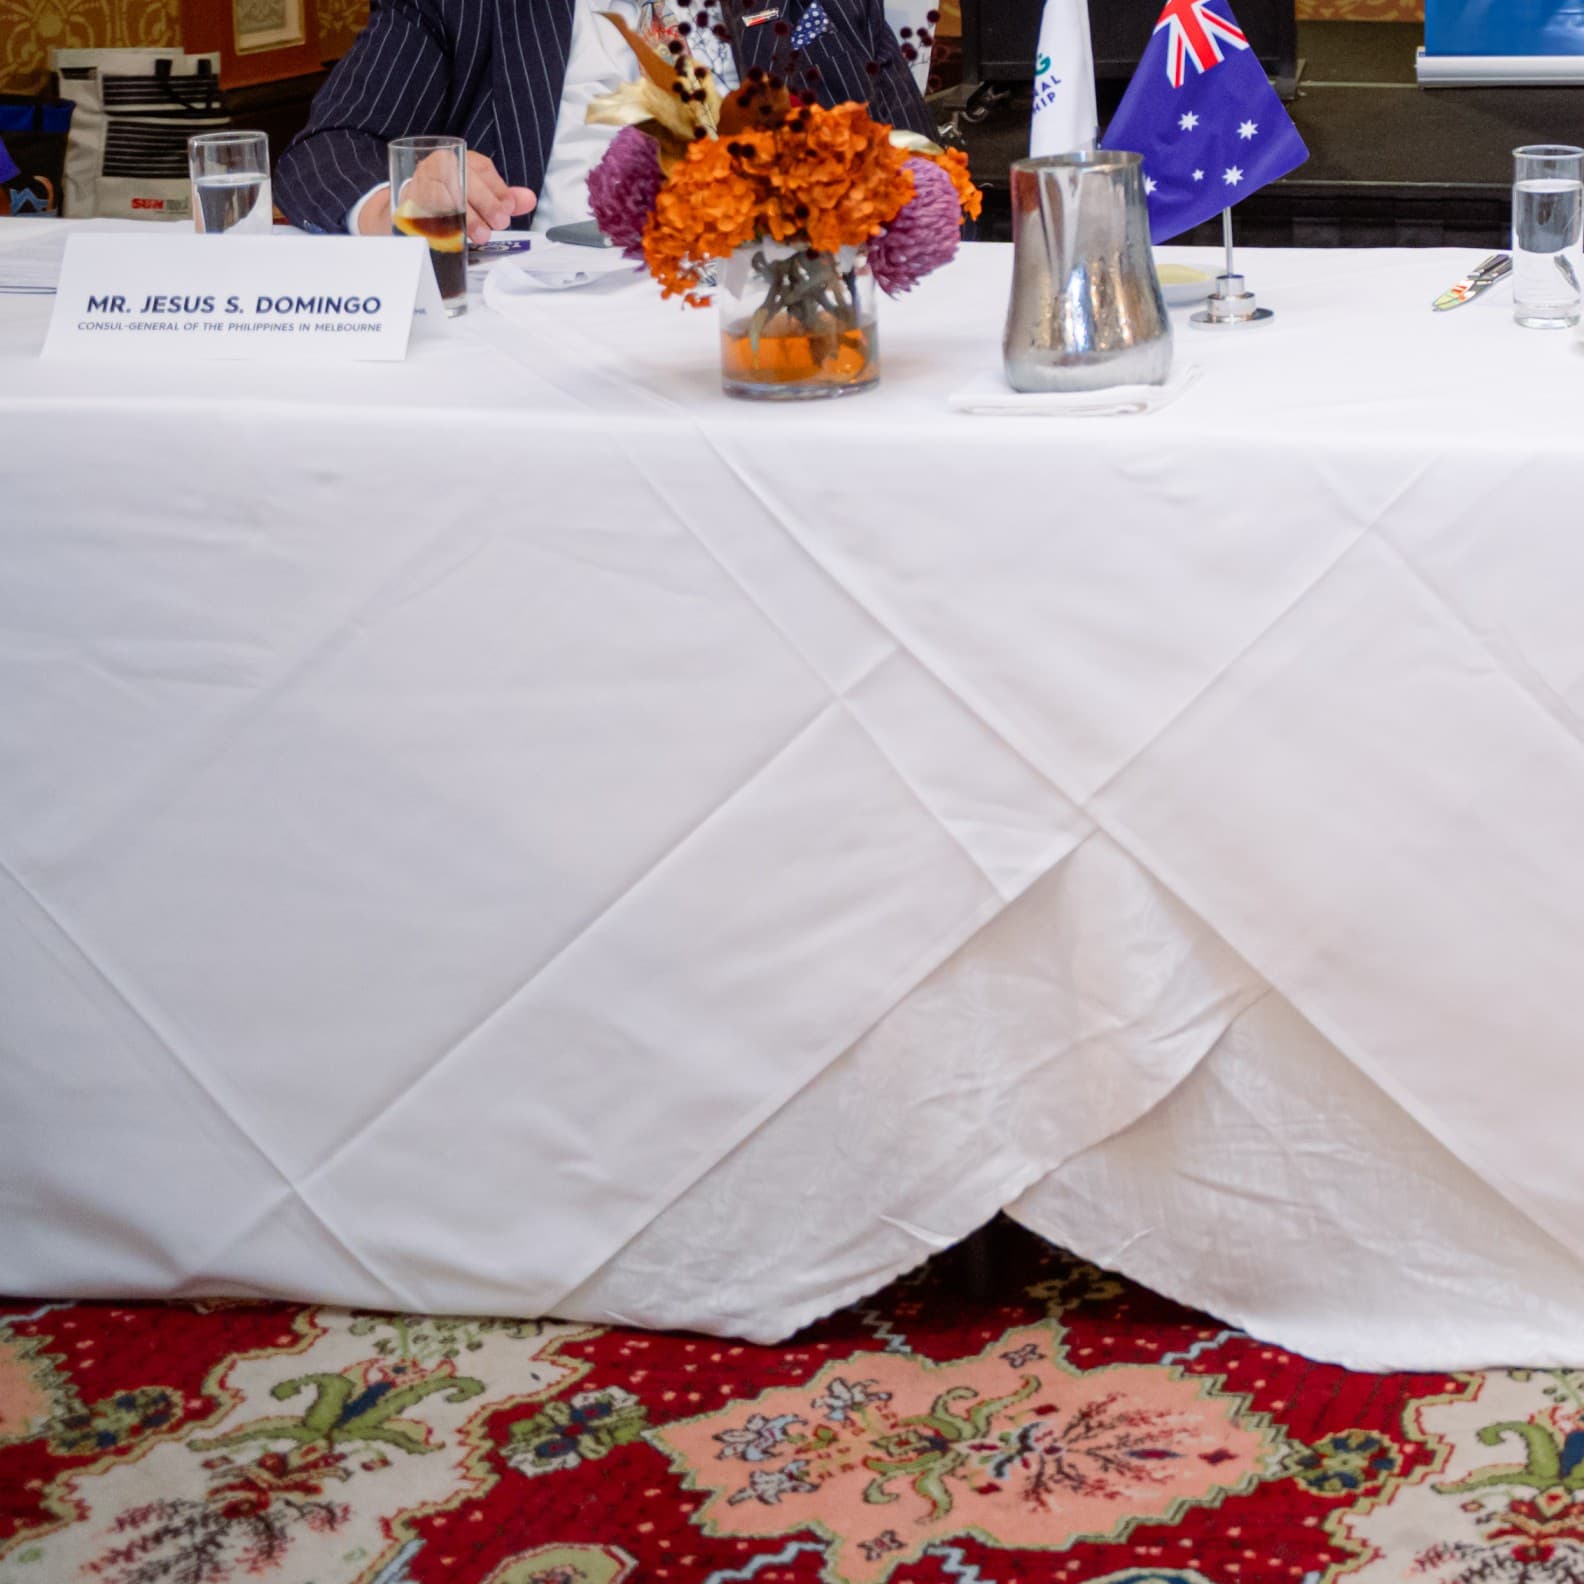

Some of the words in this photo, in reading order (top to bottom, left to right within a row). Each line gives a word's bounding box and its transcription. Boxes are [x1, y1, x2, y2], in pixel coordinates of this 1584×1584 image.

[87, 295, 131, 314] MR.
[140, 295, 215, 314] JESUS
[225, 295, 244, 314] S.
[256, 296, 381, 315] DOMINGO
[77, 322, 179, 332] CONSUL-GENERAL
[183, 322, 199, 332] OF
[203, 322, 224, 332] THE
[228, 322, 294, 332] PHILIPPINES
[299, 322, 310, 332] IN
[315, 322, 382, 333] MELBOURNE
